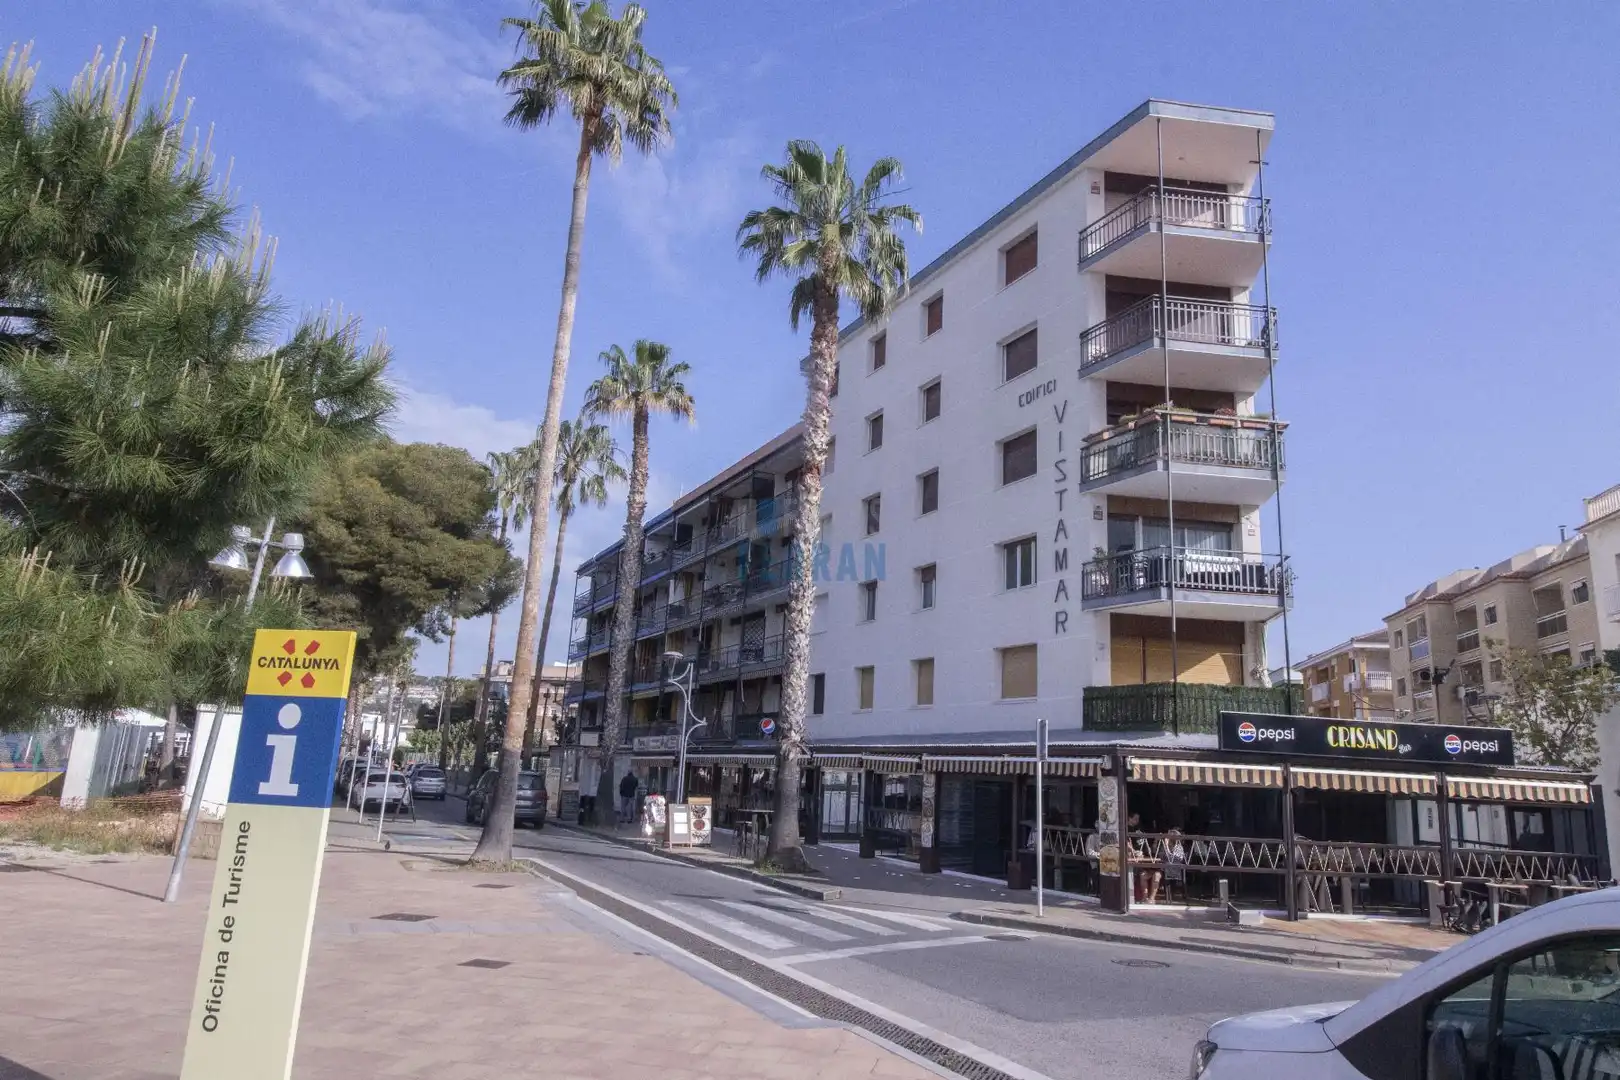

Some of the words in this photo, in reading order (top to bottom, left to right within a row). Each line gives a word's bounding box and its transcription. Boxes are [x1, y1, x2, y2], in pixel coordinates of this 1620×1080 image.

[1053, 399, 1069, 635] VISTAMAR
[257, 656, 340, 671] CATALUNYA
[1258, 727, 1295, 742] pepsi
[1326, 725, 1399, 751] CRISAND
[1462, 740, 1499, 754] pepsi
[222, 820, 251, 909] Turisme
[218, 915, 236, 943] de
[202, 950, 230, 1033] Oficina
